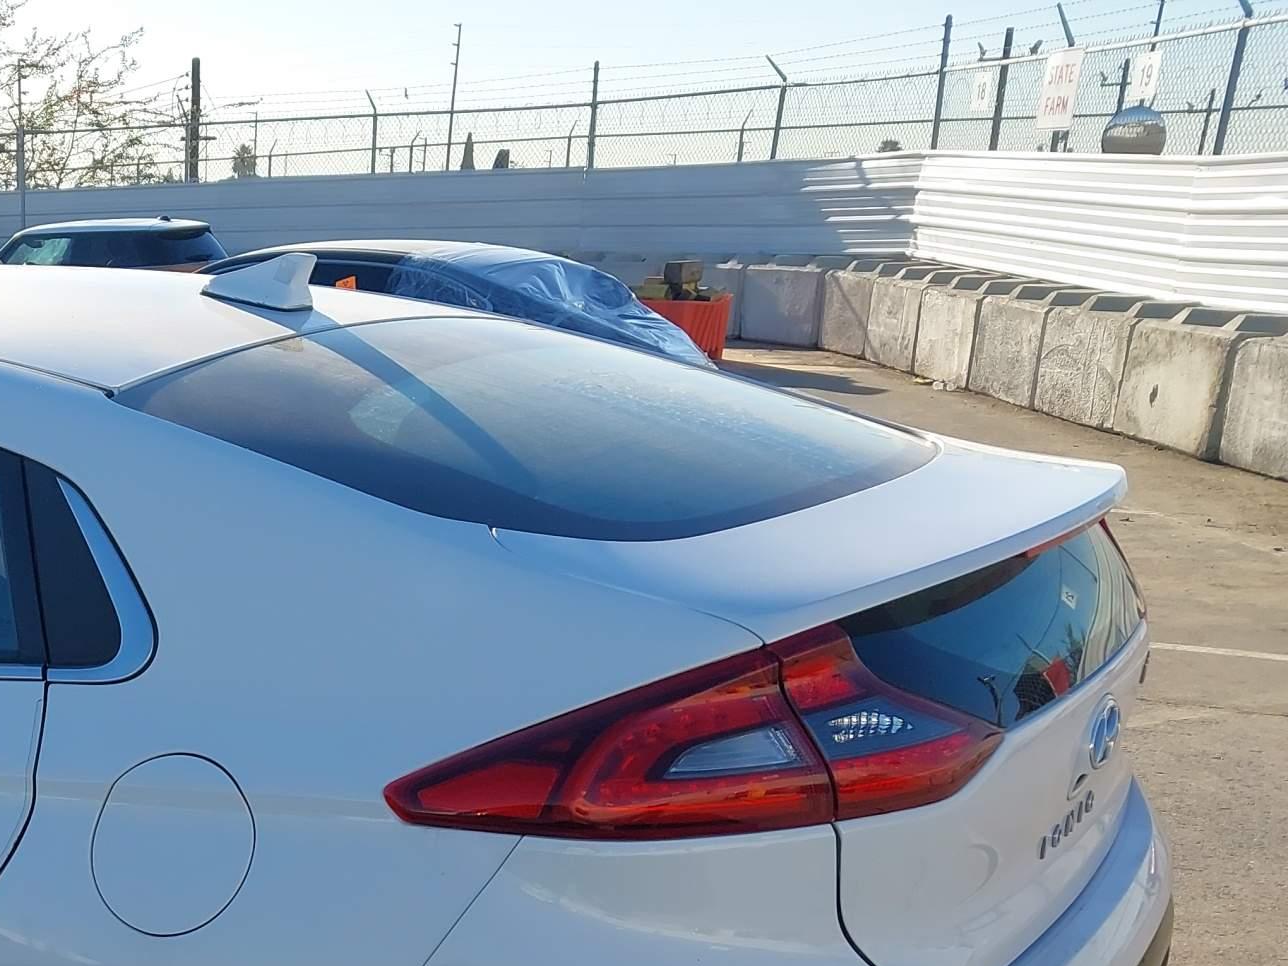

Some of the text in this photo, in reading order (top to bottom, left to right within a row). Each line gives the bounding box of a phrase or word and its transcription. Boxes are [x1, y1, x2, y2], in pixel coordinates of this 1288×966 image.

[1048, 63, 1076, 85] STATE
[1140, 64, 1153, 87] 19
[977, 81, 986, 101] 18
[1043, 96, 1069, 115] FARM
